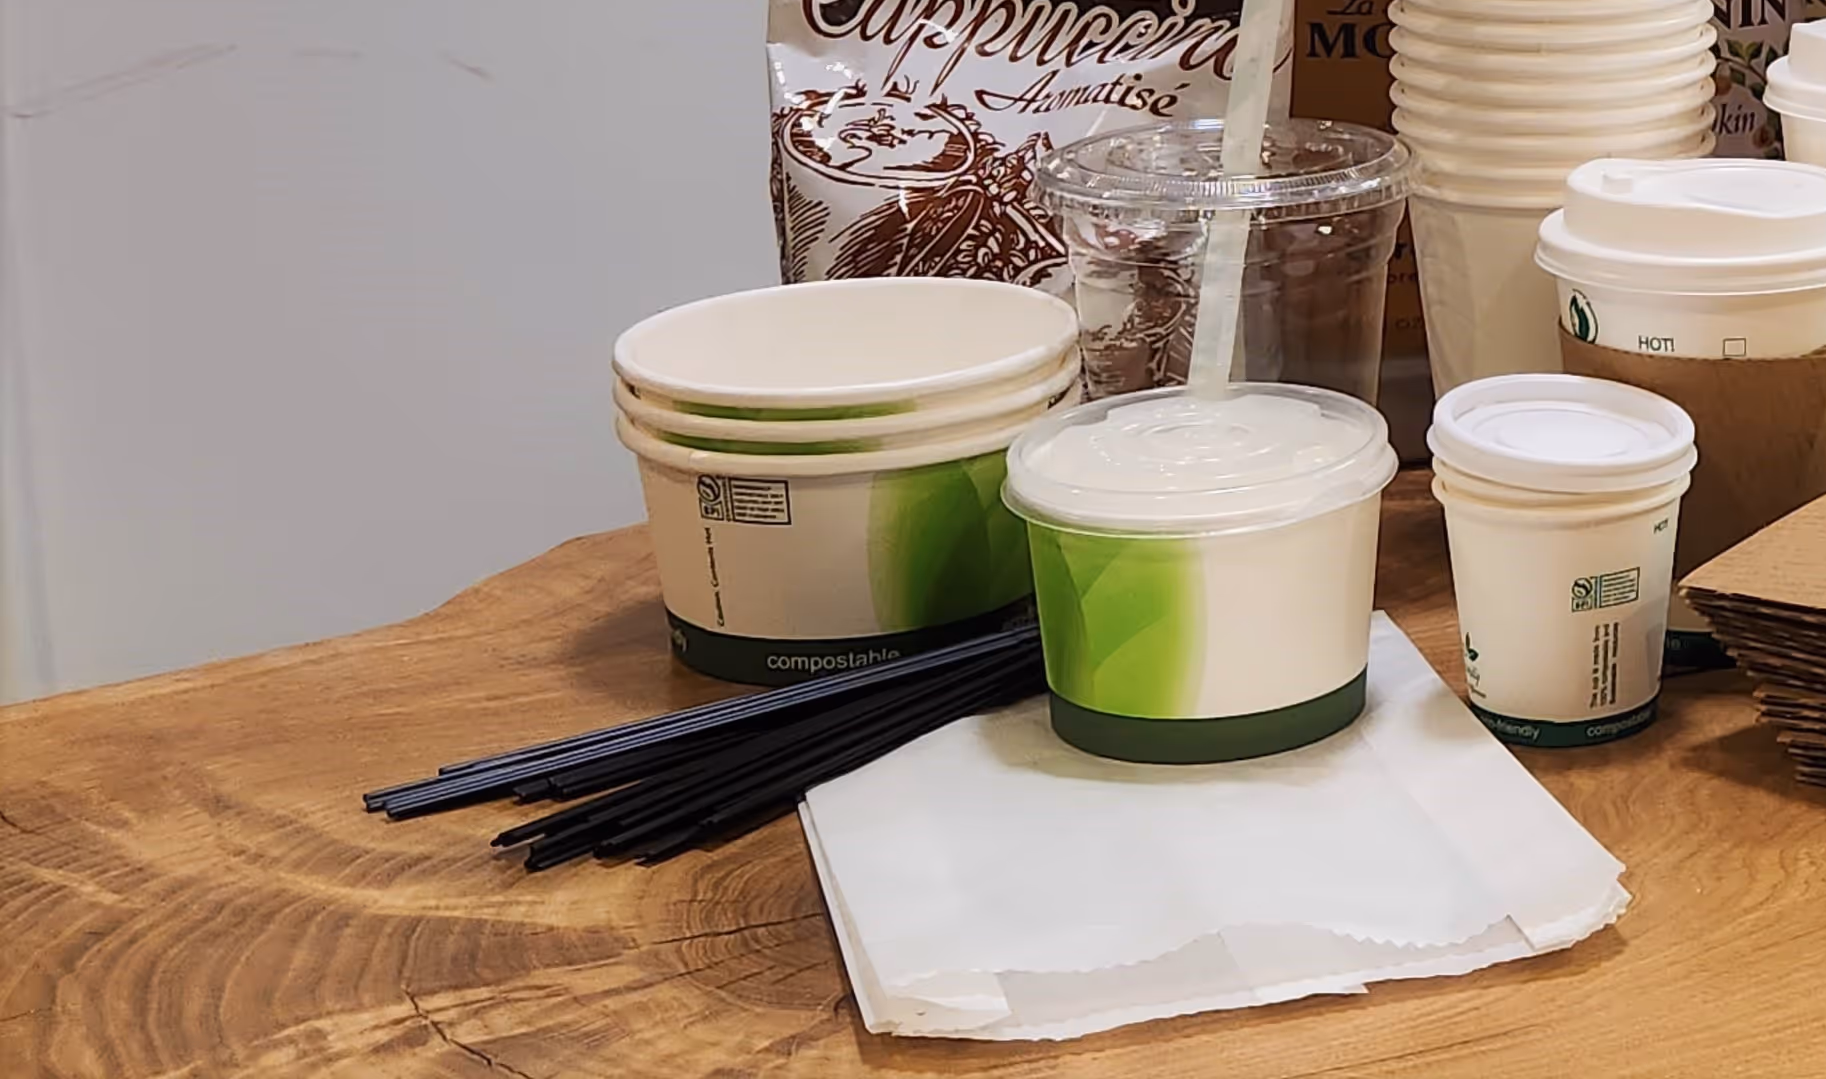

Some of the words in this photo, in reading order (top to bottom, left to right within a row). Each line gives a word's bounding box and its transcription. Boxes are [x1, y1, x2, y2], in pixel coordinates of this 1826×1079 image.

[974, 70, 1191, 118] Aromatisé
[1637, 335, 1675, 353] HOT!
[766, 647, 901, 673] compostable
